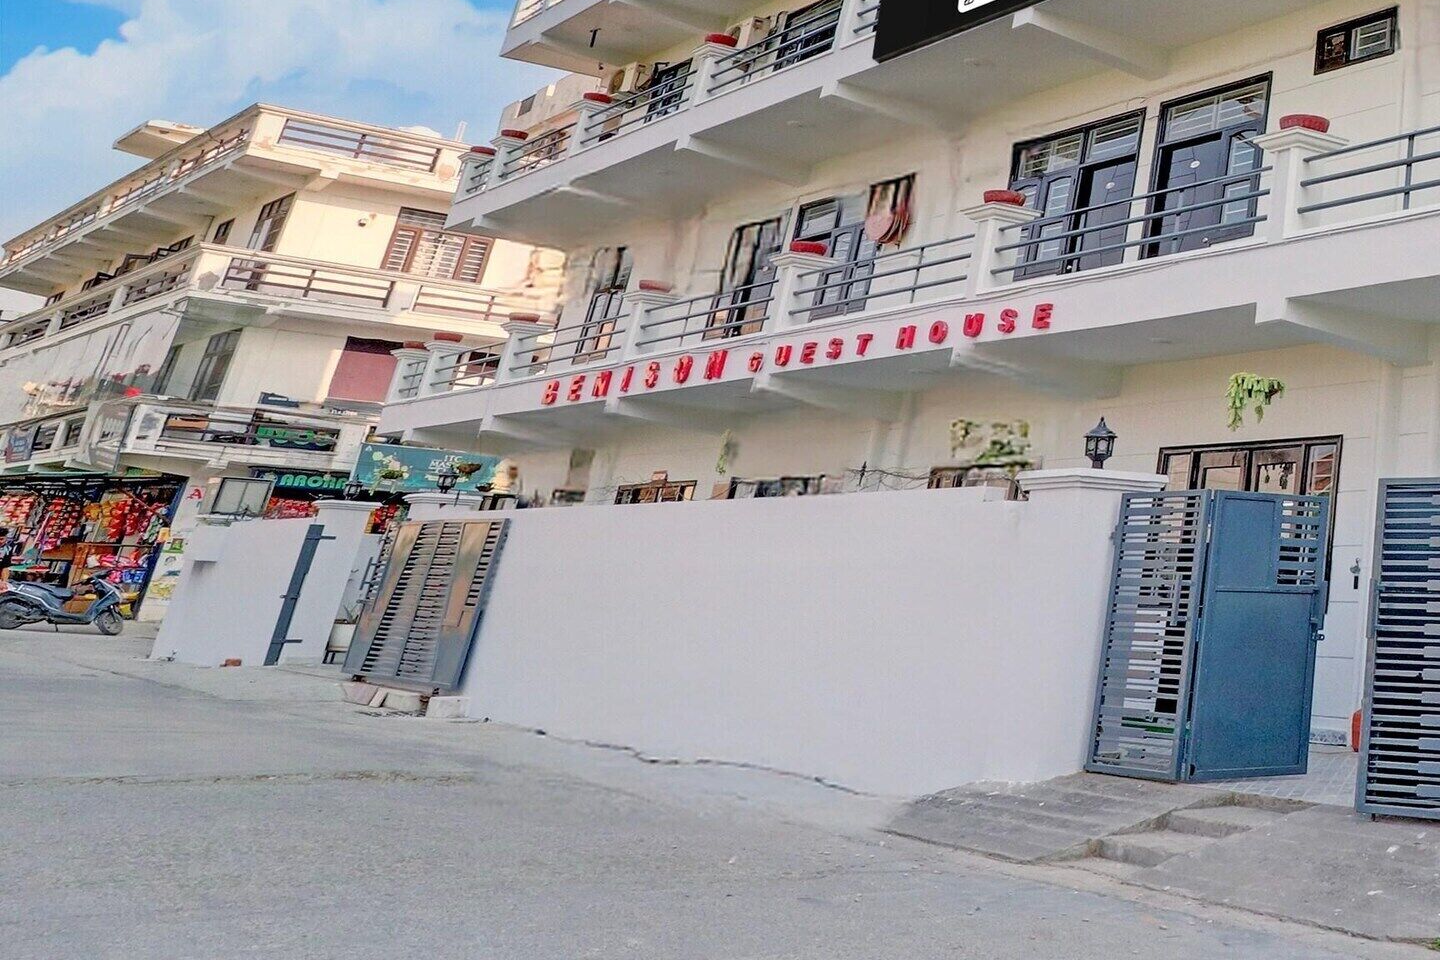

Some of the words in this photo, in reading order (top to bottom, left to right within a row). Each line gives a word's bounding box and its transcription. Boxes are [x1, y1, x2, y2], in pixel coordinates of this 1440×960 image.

[543, 349, 729, 404] BENISON
[747, 333, 873, 372] GUEST
[896, 303, 1054, 349] HOUSE
